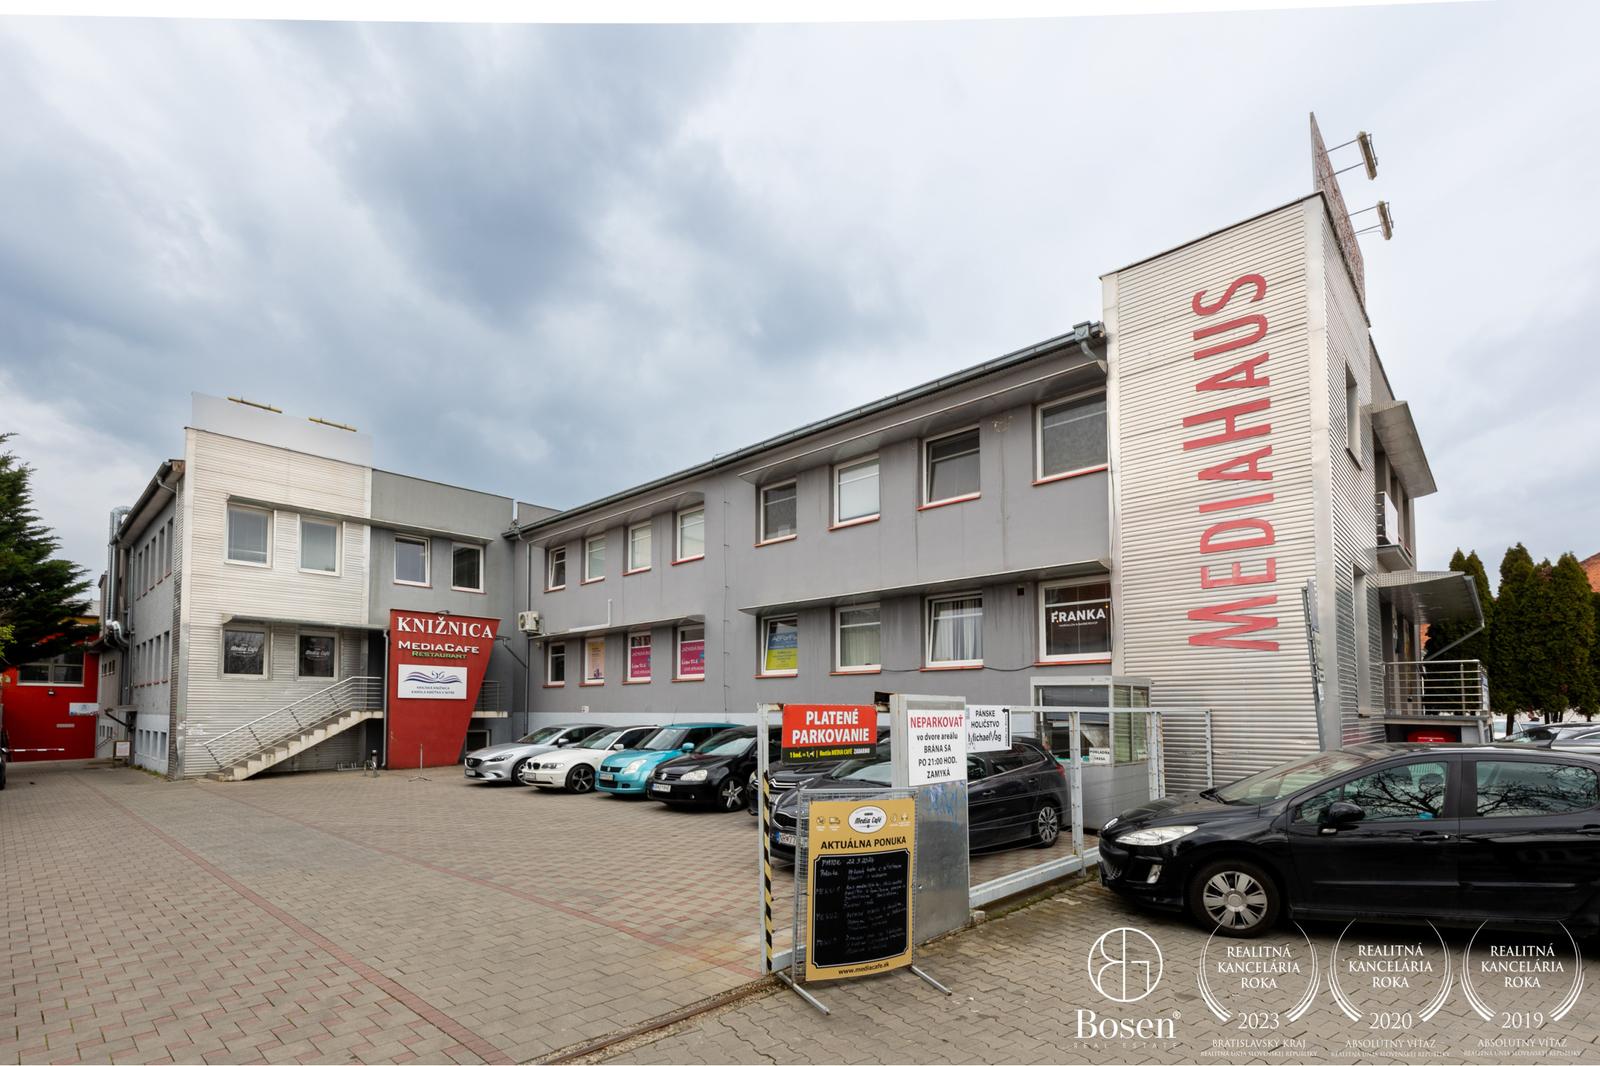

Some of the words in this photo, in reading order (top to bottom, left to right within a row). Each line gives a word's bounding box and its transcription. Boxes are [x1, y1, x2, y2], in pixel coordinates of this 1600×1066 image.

[1183, 273, 1280, 652] MEDIAHAUS
[1051, 608, 1106, 623] FRANKA
[397, 616, 494, 639] KNIŽNICA
[411, 651, 467, 659] RESTAURANT
[806, 708, 859, 726] PLATENÉ
[975, 708, 996, 717] PÁNSKE
[910, 716, 963, 729] NEPARKOVAŤ
[970, 719, 1000, 728] HOLIČSTVO
[792, 727, 869, 745] PARKOVANIE
[941, 732, 958, 740] areálu
[924, 742, 943, 753] BRÁNA
[944, 744, 952, 752] SA
[919, 758, 927, 767] PO
[927, 757, 943, 766] 21:00
[943, 756, 957, 765] HOD.
[927, 768, 951, 779] ZAMYKÁ
[820, 837, 872, 850] AKTUÁLNA
[874, 836, 907, 847] PONUKA
